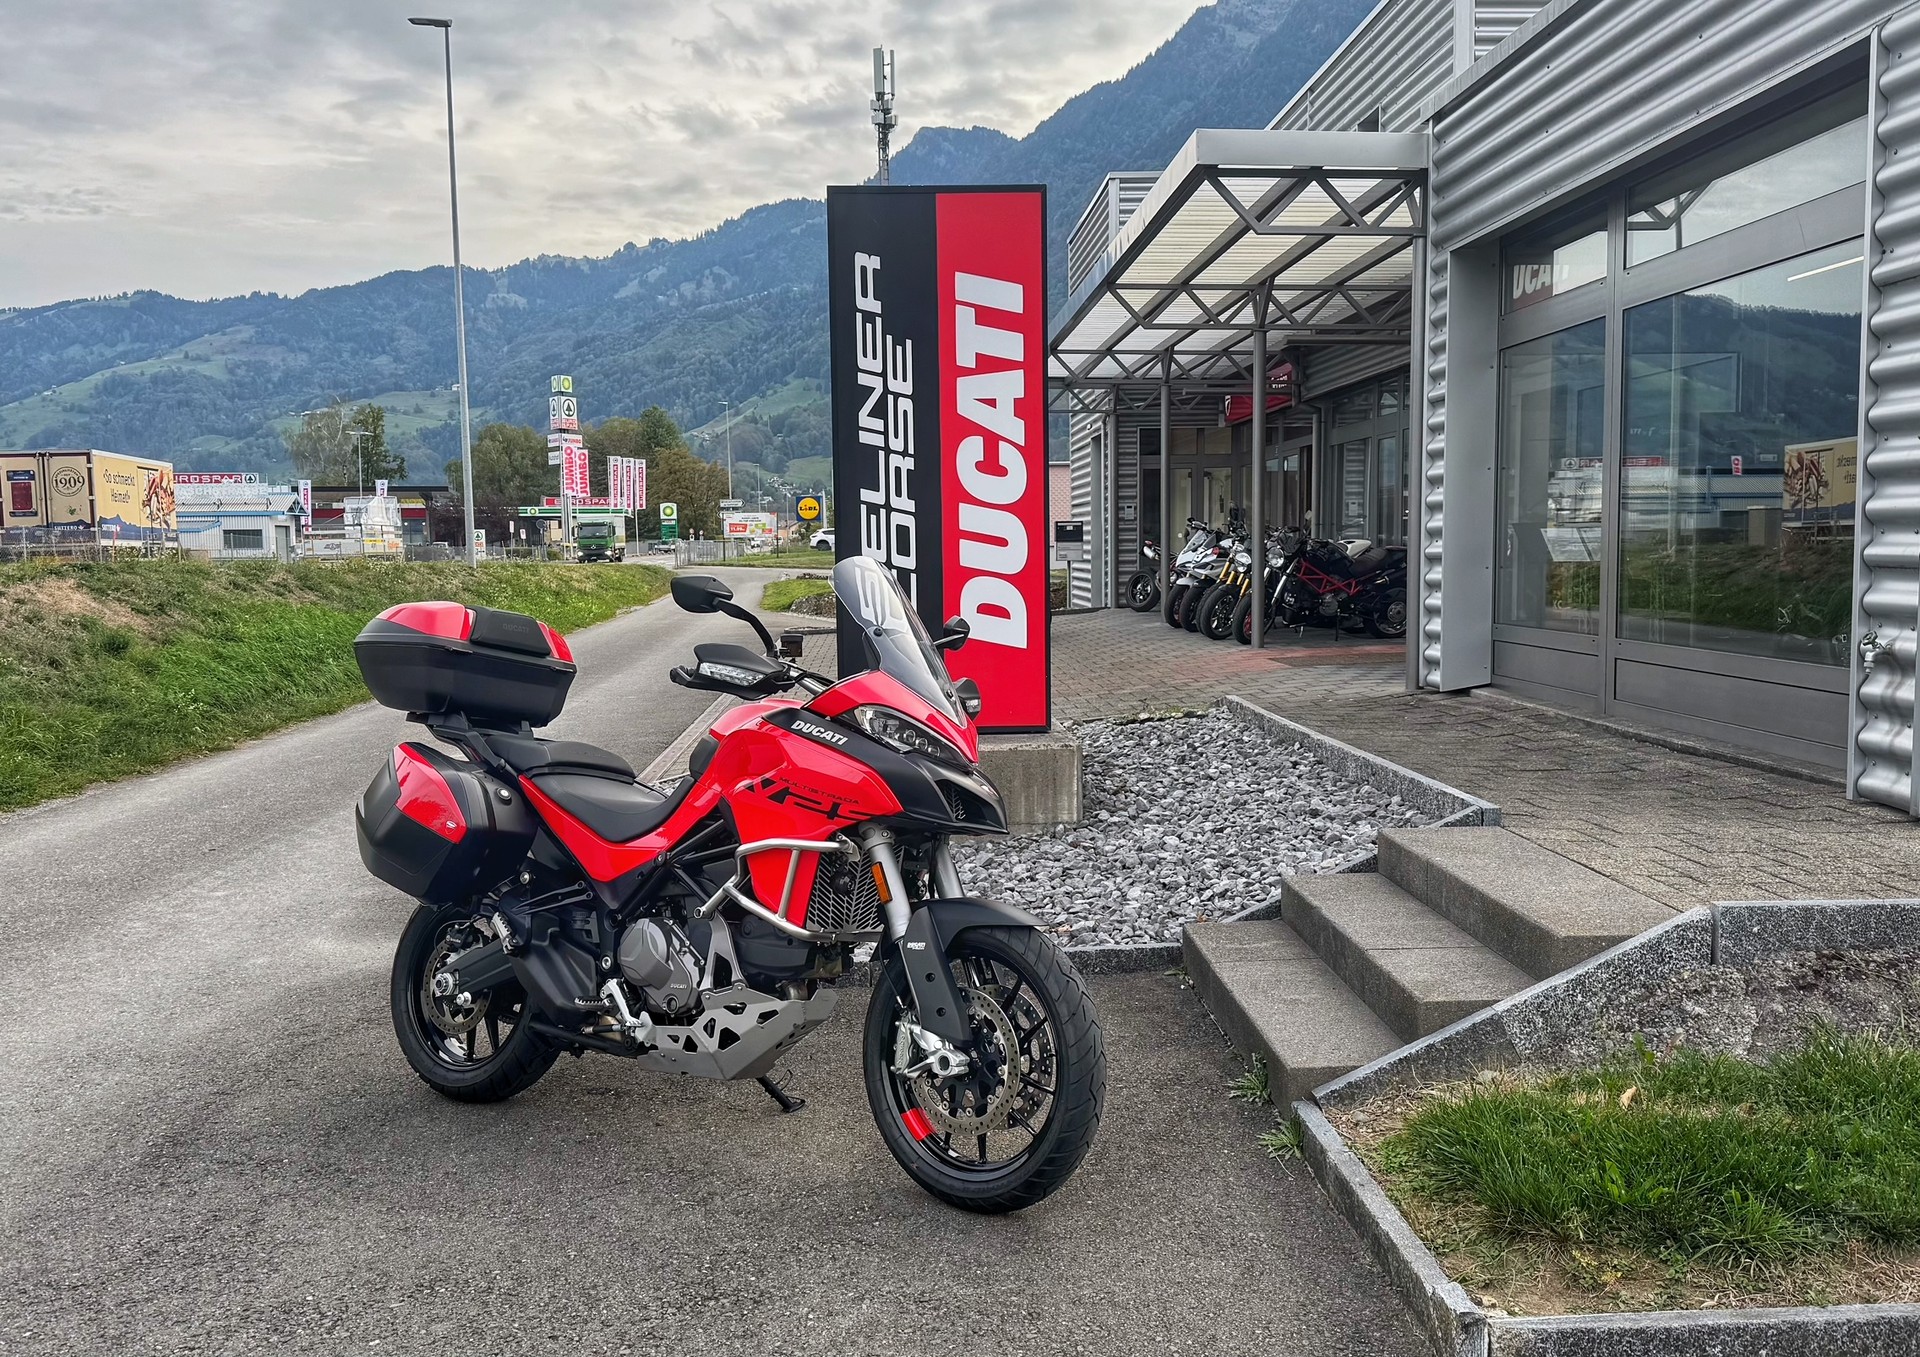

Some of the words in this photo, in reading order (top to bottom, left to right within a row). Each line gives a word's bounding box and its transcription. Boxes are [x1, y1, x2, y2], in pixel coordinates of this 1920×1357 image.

[854, 250, 887, 624] SELINER
[564, 446, 575, 493] JUMBO
[578, 452, 589, 495] JUMBO
[955, 271, 1029, 650] DUCATI
[54, 475, 85, 489] 1909
[502, 623, 529, 634] DUCATI
[790, 720, 848, 746] DUCATI
[778, 777, 860, 805] MULTISTRADA
